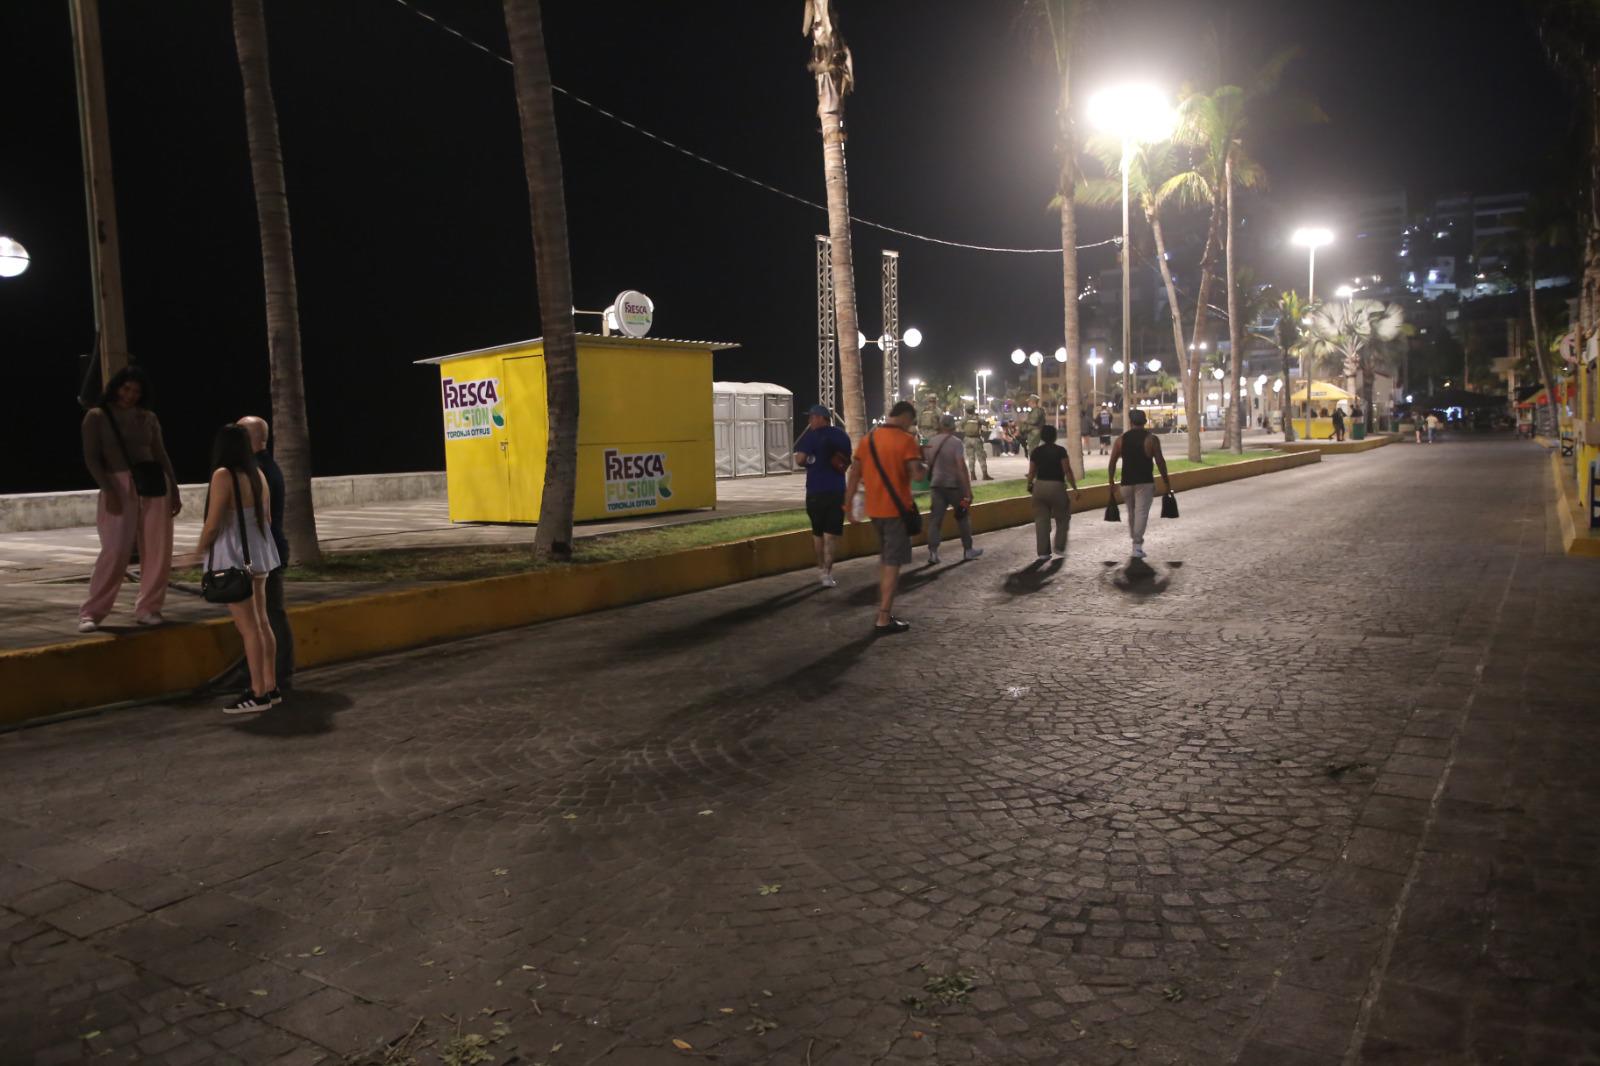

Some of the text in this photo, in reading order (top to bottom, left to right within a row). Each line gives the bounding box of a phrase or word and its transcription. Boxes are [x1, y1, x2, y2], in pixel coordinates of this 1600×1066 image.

[624, 301, 648, 315] FRESCA
[442, 378, 498, 409] FRESCA
[446, 427, 491, 439] TORONJA CITRUS
[605, 450, 665, 481] FRESCA
[608, 498, 656, 510] TORONJA CITRUS
